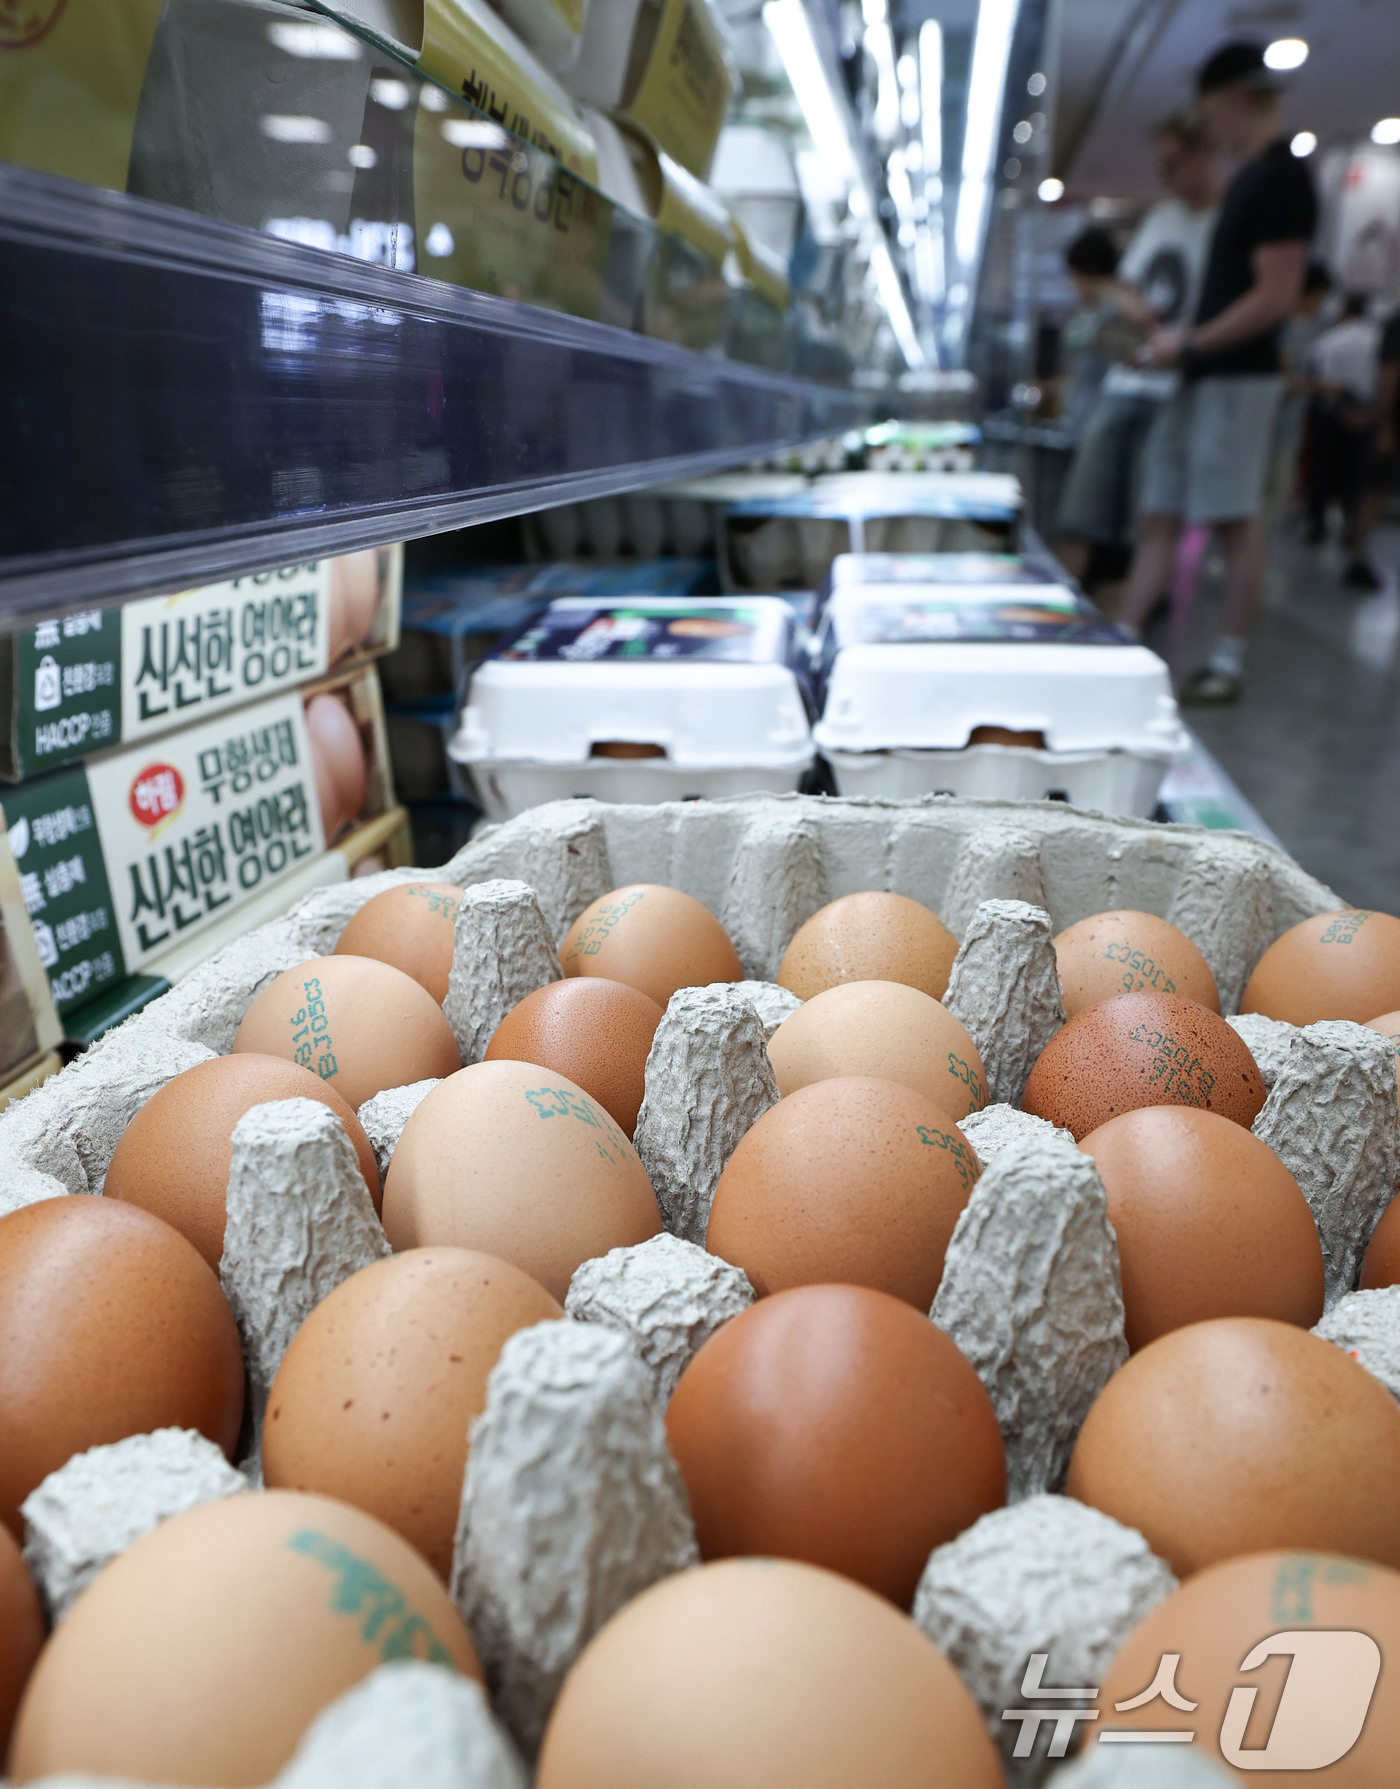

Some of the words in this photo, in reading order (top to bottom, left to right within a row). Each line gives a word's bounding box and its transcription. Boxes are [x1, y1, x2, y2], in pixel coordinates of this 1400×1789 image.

[134, 608, 235, 722] 신선한
[241, 590, 317, 687] 영양란
[35, 711, 92, 756] HACCP
[198, 717, 299, 805] 무항생제
[128, 821, 232, 953] 신선한
[228, 780, 314, 891] 영양란
[51, 959, 94, 1005] ACCP
[290, 1008, 315, 1072] 816
